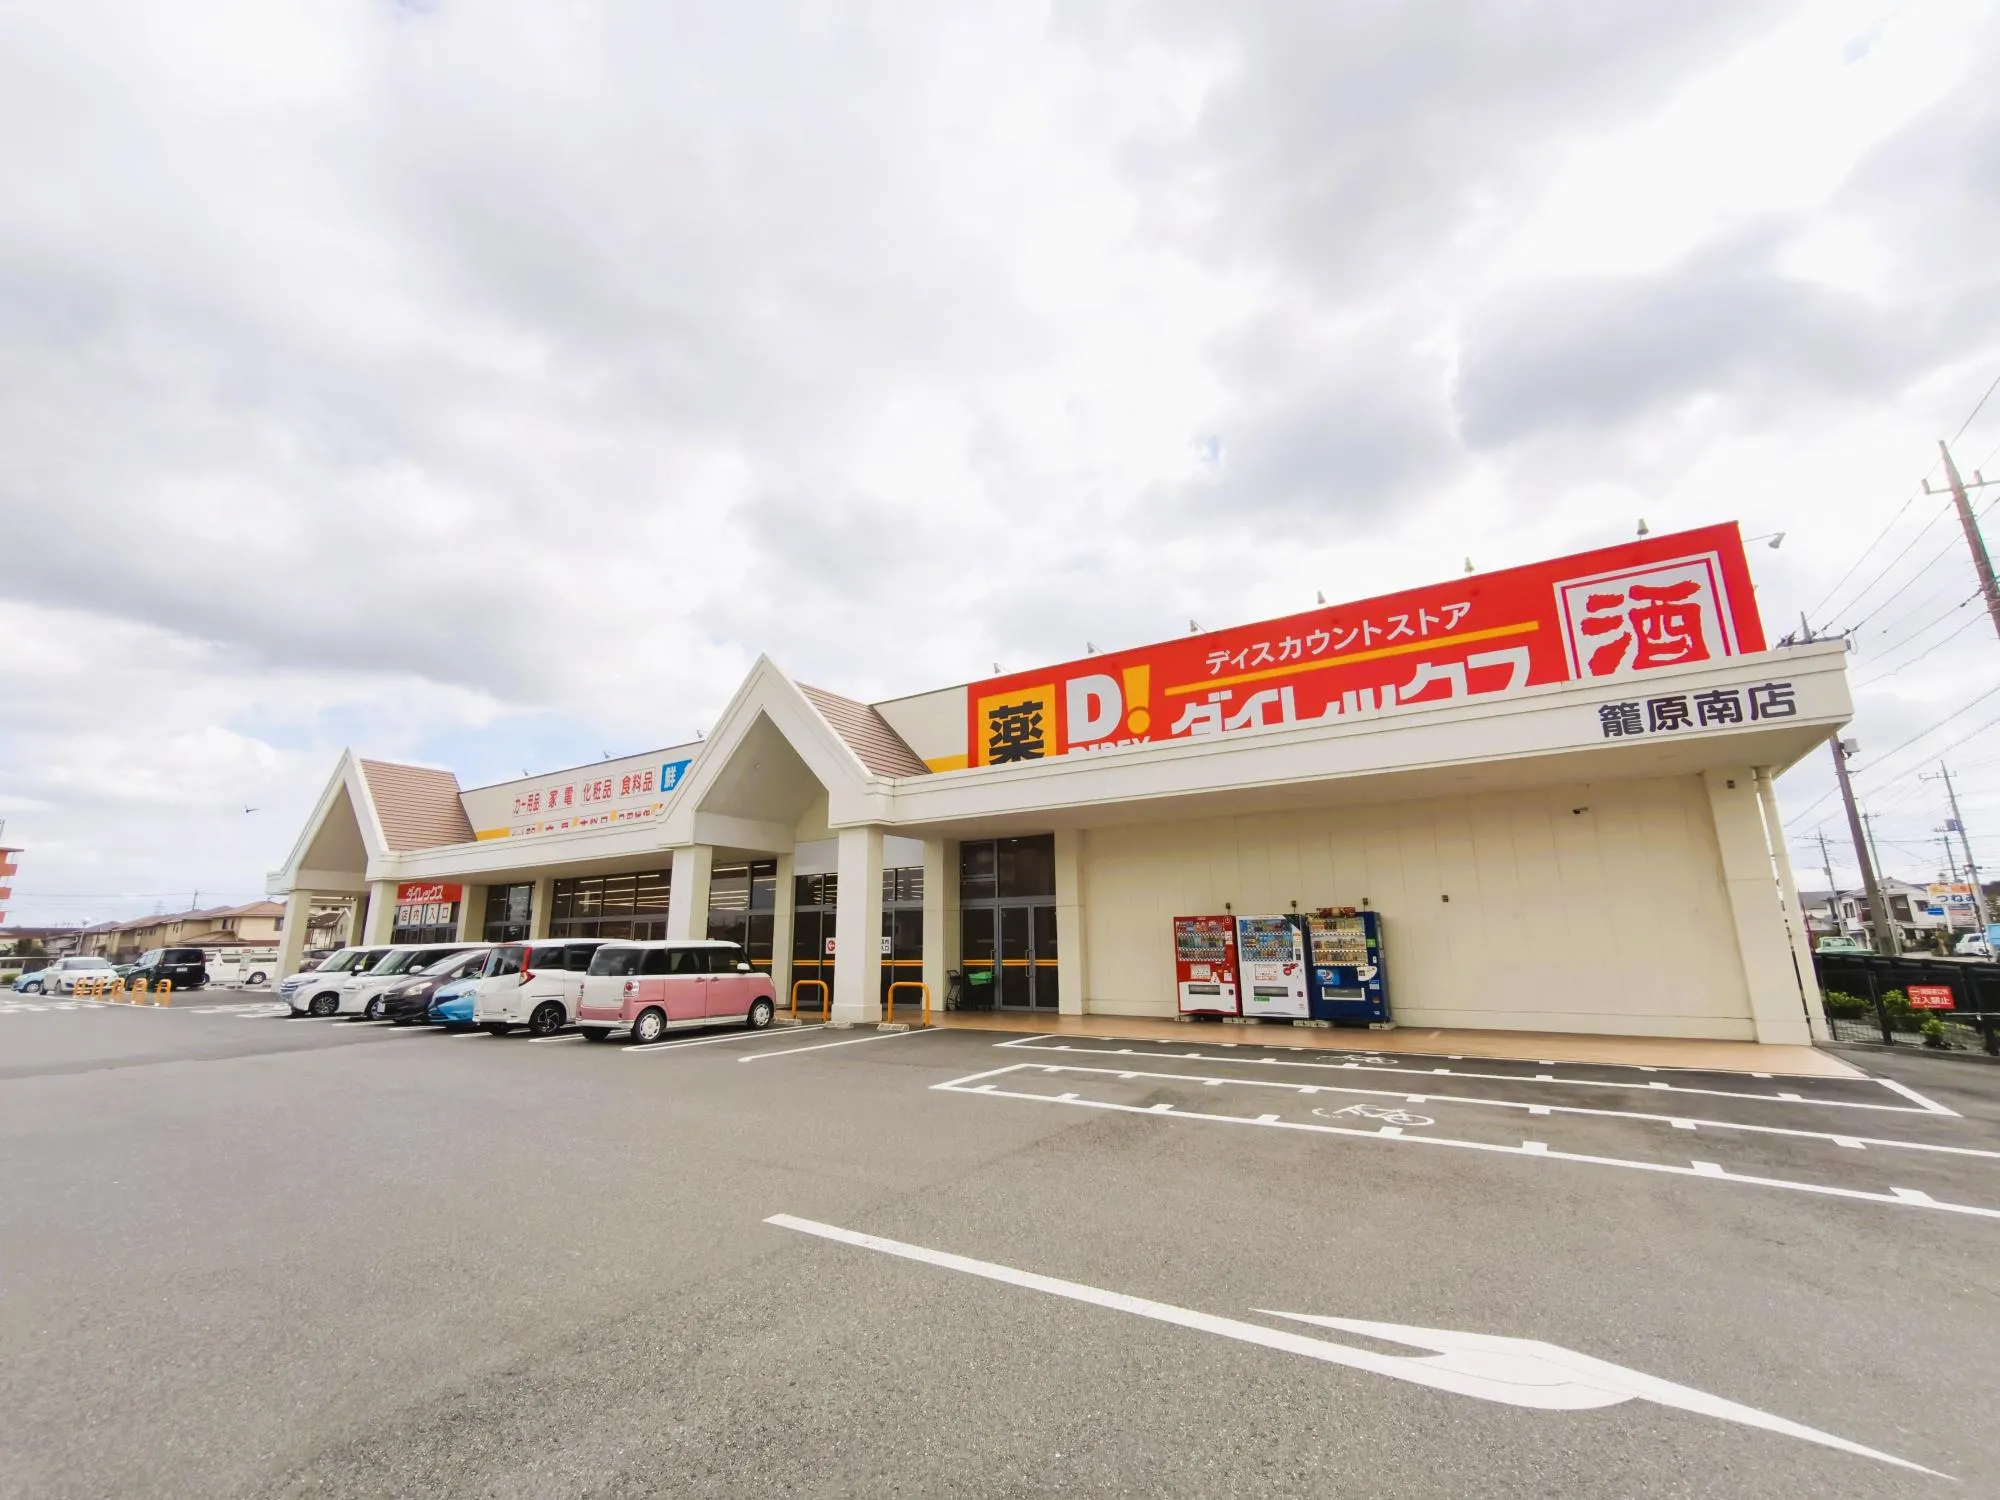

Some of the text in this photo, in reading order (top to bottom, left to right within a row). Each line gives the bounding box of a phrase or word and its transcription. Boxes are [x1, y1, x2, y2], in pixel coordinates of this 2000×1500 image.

[1205, 602, 1471, 675] ディスカウントストア
[1580, 580, 1711, 677] 酒
[988, 700, 1045, 765] 薬
[1599, 682, 1796, 738] 籠原南店
[583, 780, 612, 802] 化粧品
[621, 771, 653, 795] 食料品
[1911, 996, 1951, 1005] 立入禁止
